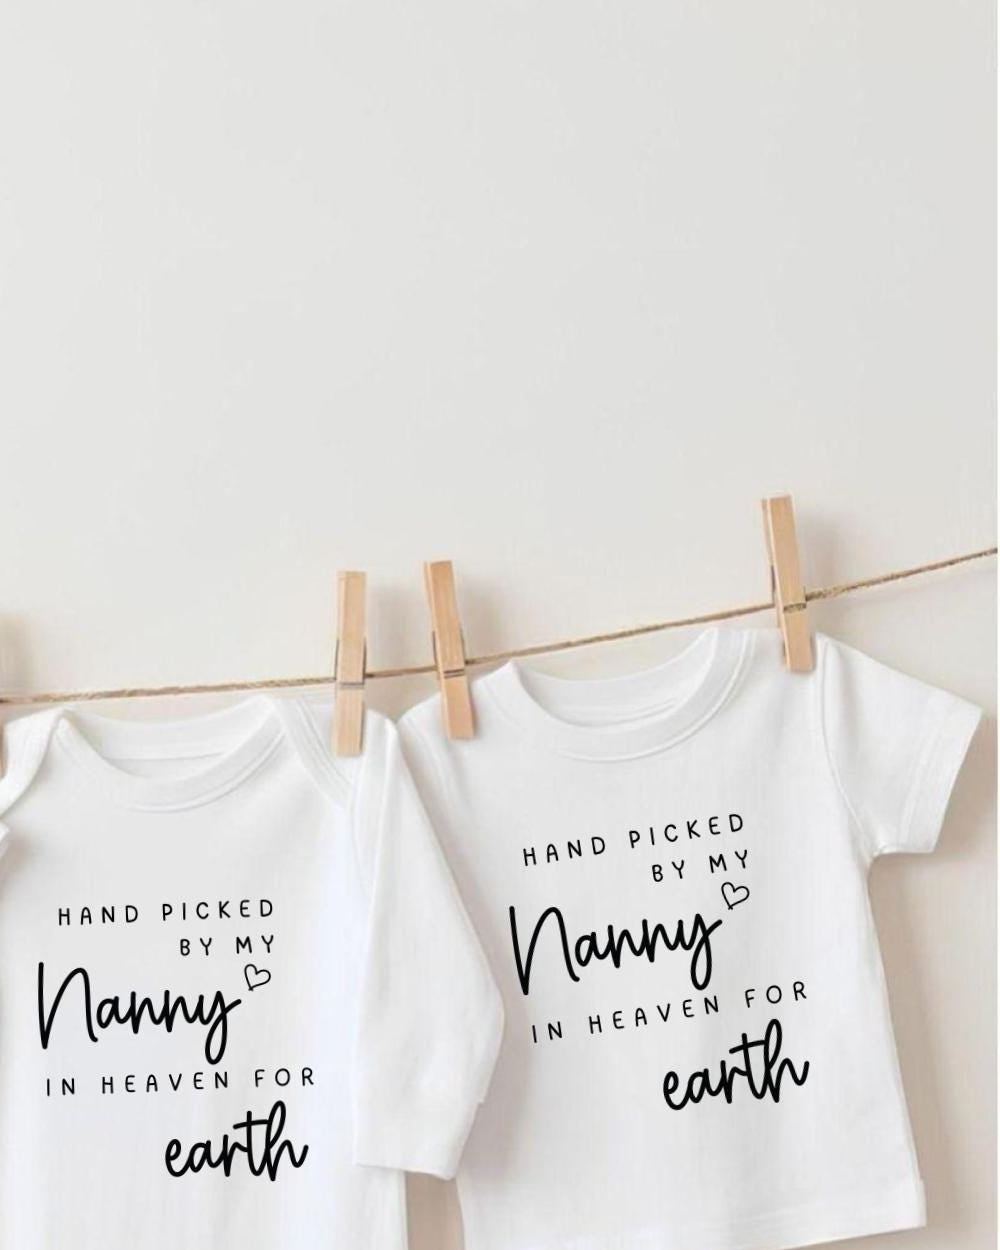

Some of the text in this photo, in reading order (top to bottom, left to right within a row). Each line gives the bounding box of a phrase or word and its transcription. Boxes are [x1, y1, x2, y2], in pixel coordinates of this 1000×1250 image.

[522, 813, 744, 867] HAND PICKED
[651, 848, 748, 883] BY MY
[58, 898, 273, 927] HAND PICKED
[179, 934, 274, 957] BY MY
[508, 905, 724, 997] Nanny
[37, 961, 243, 1066] Nanny
[531, 980, 808, 1044] IN HEAVEN FOR
[46, 1066, 315, 1097] IN HEAVEN FOR
[662, 1018, 810, 1111] earth
[164, 1099, 310, 1182] earth
